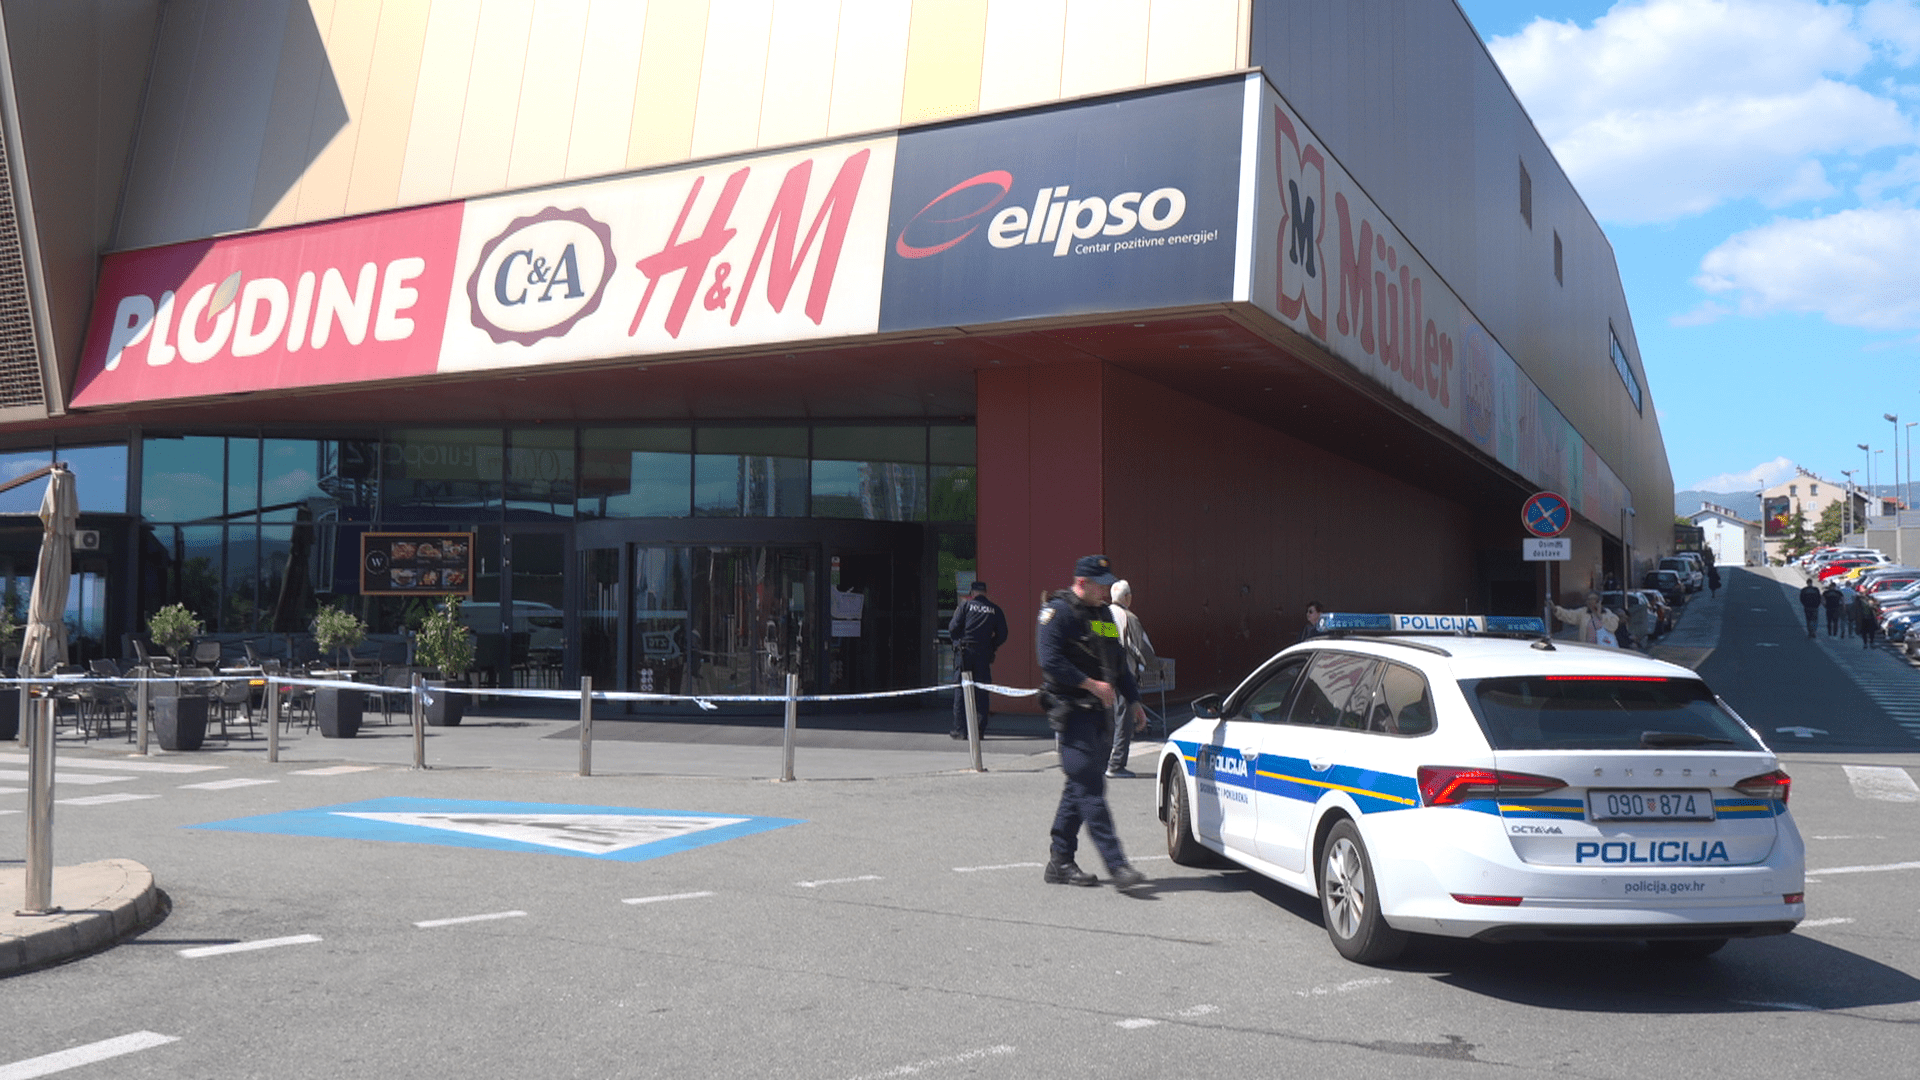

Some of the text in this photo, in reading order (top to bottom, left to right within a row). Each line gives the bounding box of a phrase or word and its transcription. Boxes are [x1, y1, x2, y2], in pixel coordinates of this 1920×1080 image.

[987, 185, 1186, 257] elipso
[628, 148, 870, 339] H&M
[1075, 229, 1218, 255] Centar pozitivne energije!
[494, 242, 585, 307] C&A
[1335, 192, 1453, 409] Müller
[105, 257, 425, 371] PLODINE
[1400, 616, 1478, 631] POLICIJA
[1209, 754, 1248, 778] POLICIJA
[1607, 794, 1697, 816] 090 874
[1576, 841, 1729, 863] POLICIJA
[1625, 880, 1705, 894] policija.gov.hr
